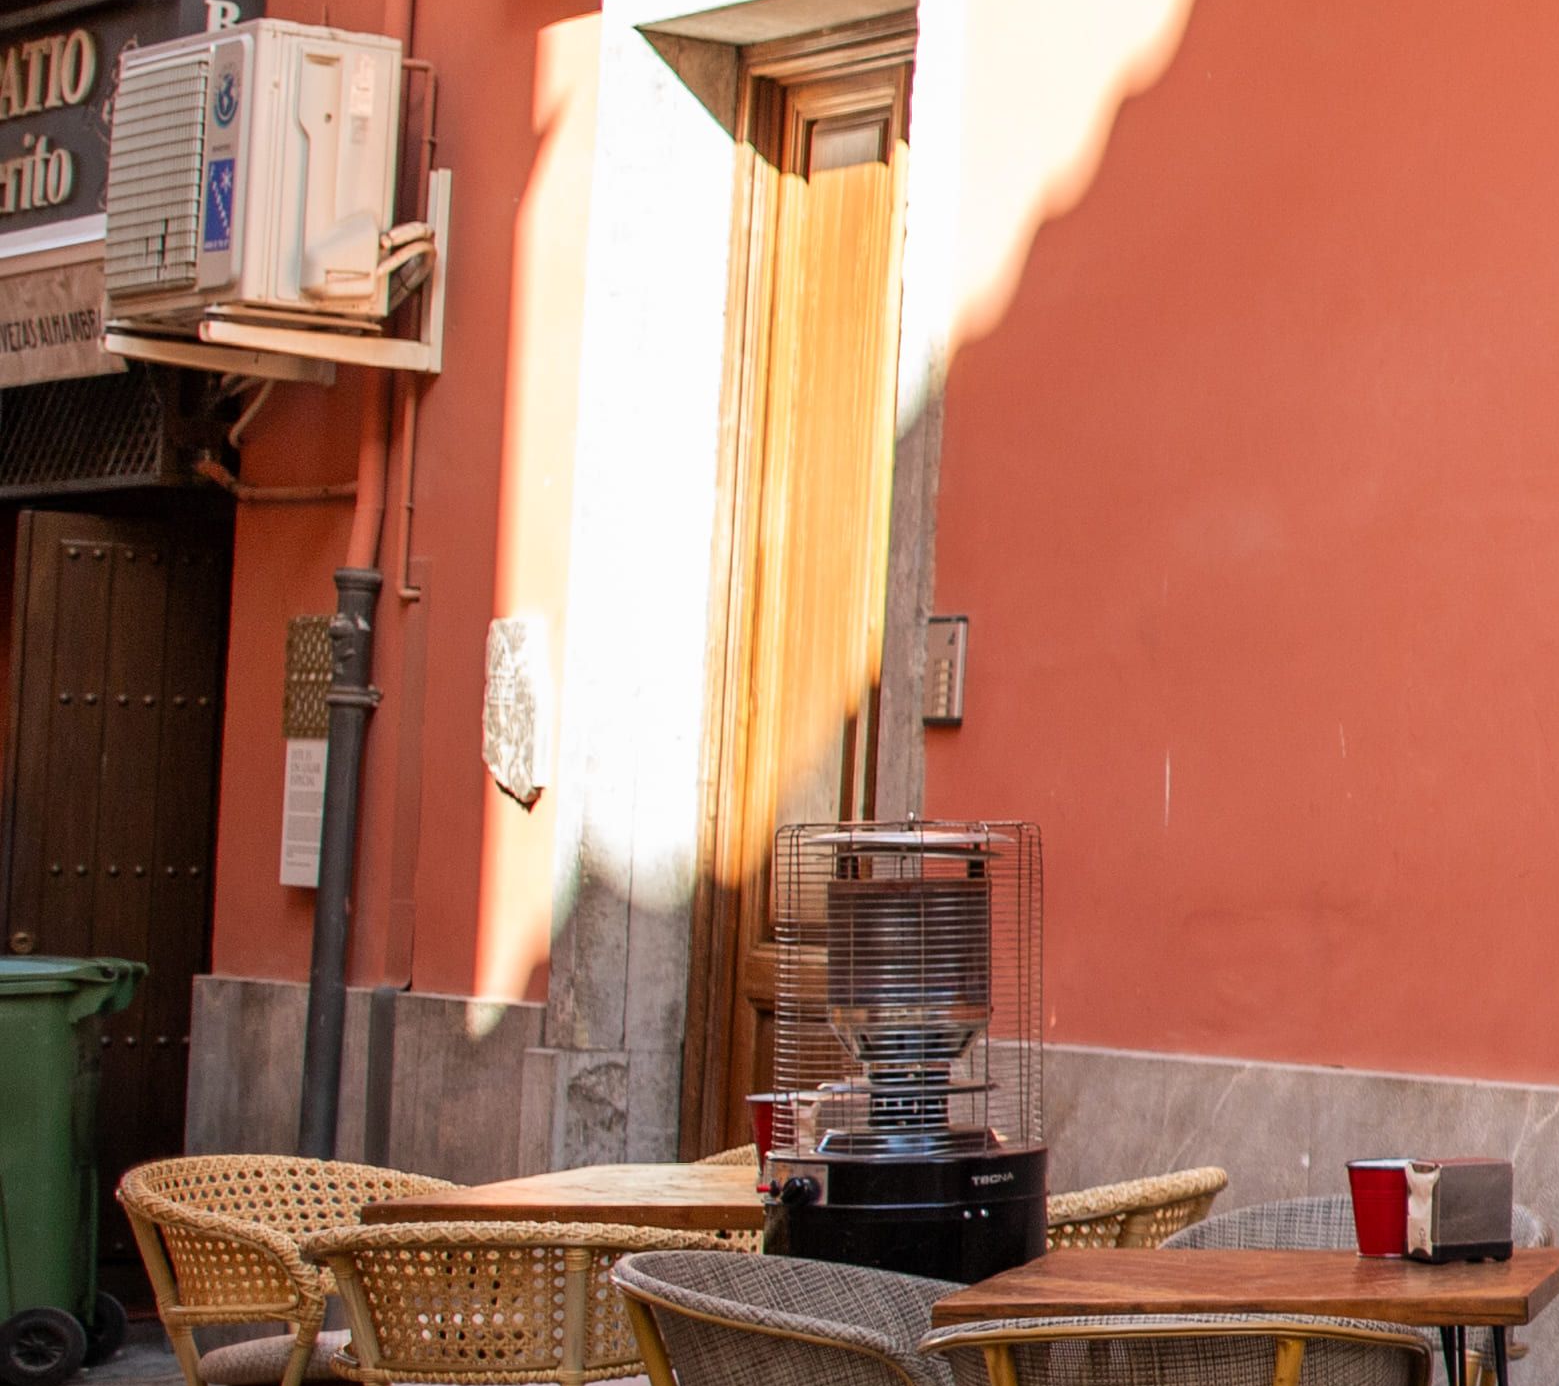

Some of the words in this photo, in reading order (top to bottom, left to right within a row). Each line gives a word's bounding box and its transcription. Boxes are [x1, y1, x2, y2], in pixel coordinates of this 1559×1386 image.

[0, 29, 96, 120] ATIO
[0, 133, 72, 213] rito
[38, 308, 101, 346] ALHAMBR
[971, 1171, 1015, 1187] TECNA
